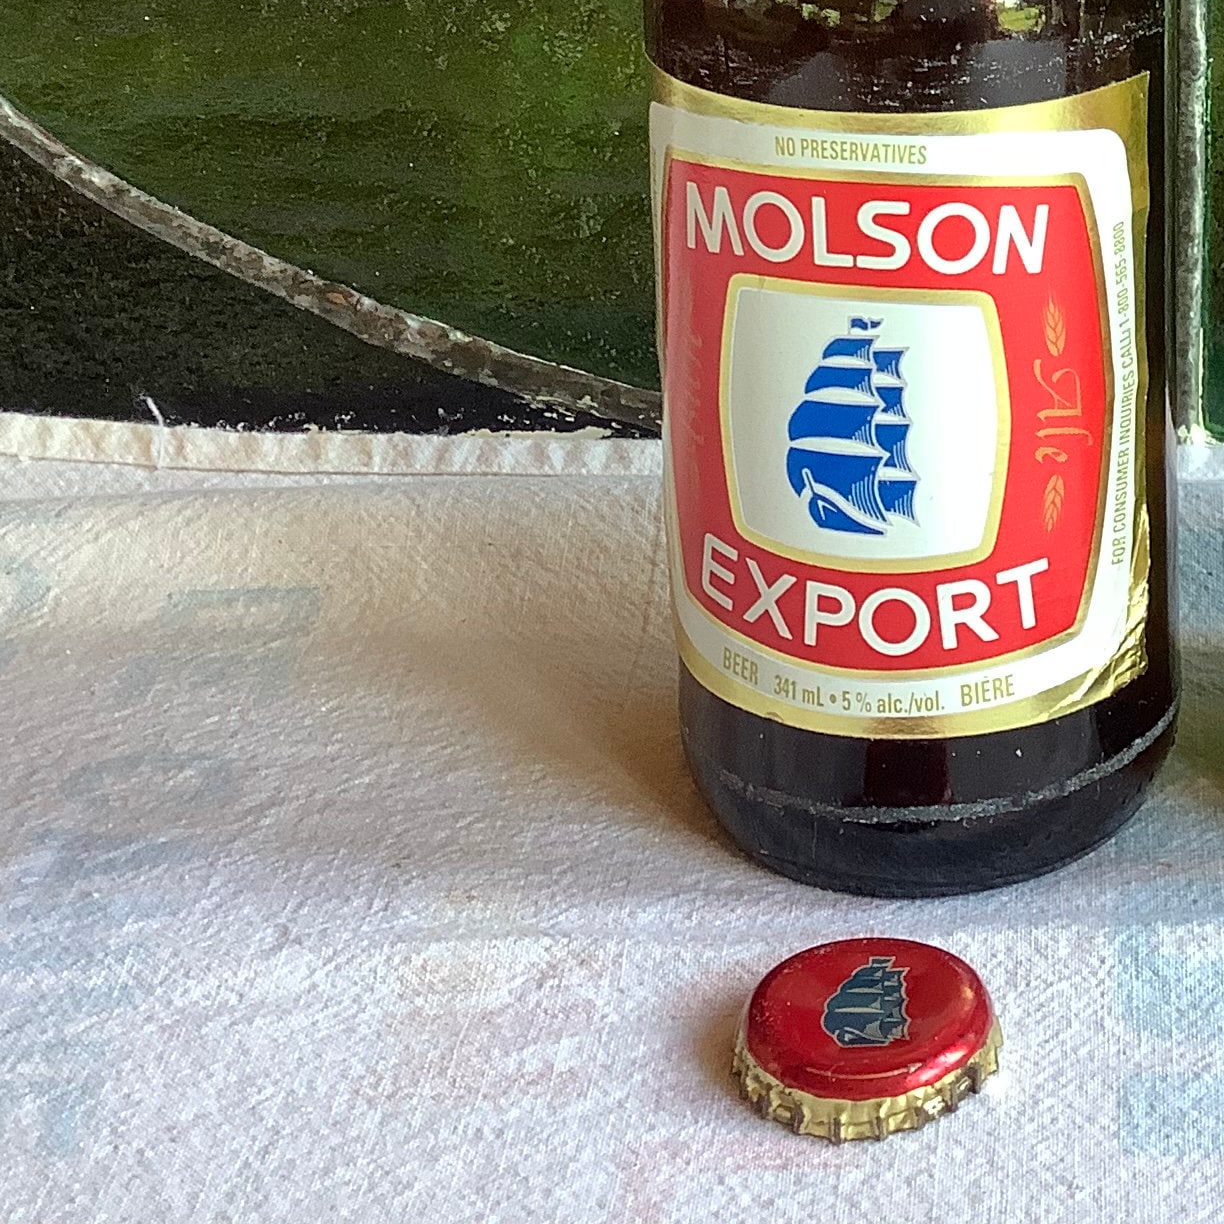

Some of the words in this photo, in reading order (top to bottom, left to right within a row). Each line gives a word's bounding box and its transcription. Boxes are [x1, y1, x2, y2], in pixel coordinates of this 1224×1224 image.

[775, 136, 797, 158] NO
[801, 138, 927, 165] PRESERVATIVES
[686, 181, 1049, 274] MOLSON
[1112, 221, 1130, 328] 1-800-565-8800
[1119, 370, 1136, 446] INQUIRIES
[1113, 447, 1129, 533] CONSUMER
[1111, 535, 1127, 565] FOR
[701, 532, 1050, 656] EXPORT
[723, 646, 759, 685] BEER
[774, 674, 797, 701] 341
[802, 687, 825, 707] mL
[877, 690, 945, 715] alc./vol.
[960, 674, 1015, 707] BIÈRE
